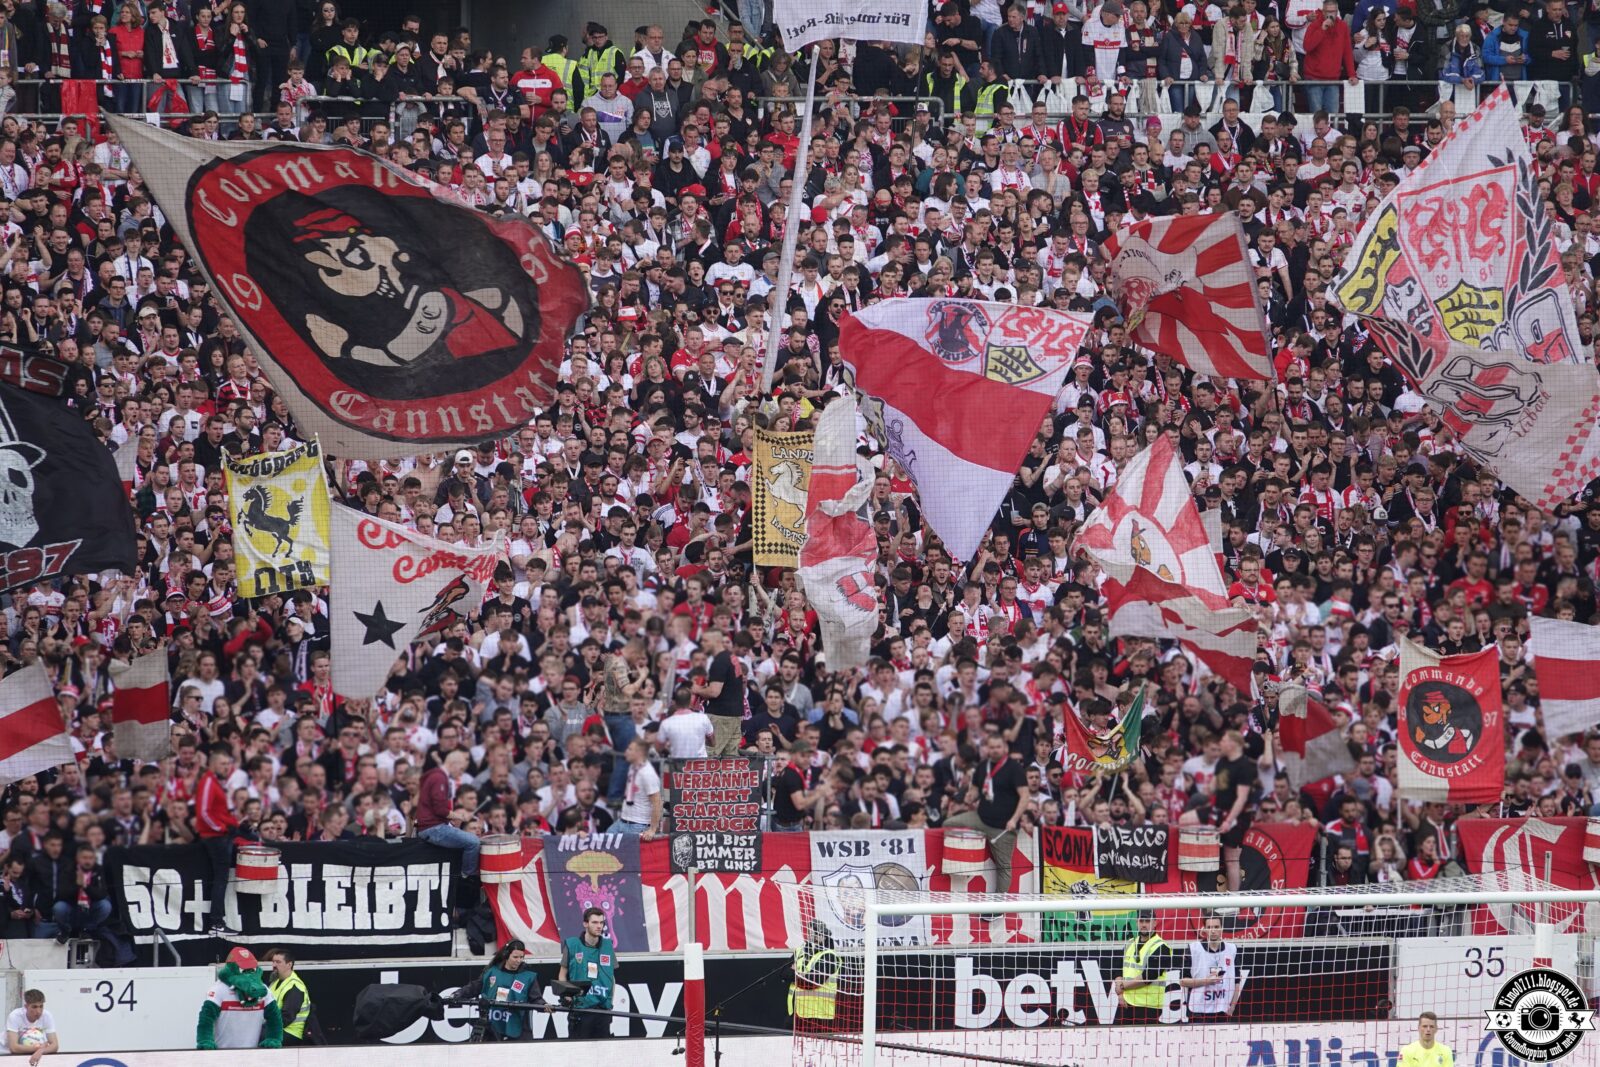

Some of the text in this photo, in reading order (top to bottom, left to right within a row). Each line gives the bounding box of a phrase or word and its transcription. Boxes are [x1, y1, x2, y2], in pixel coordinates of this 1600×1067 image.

[197, 155, 400, 228] Comman
[1404, 668, 1484, 697] Commando
[1483, 711, 1498, 728] 97
[682, 758, 750, 772] JEDER
[1410, 750, 1484, 778] Cannstatt
[672, 770, 760, 789] VERBANNTE
[682, 787, 753, 803] KEHRT
[695, 834, 757, 847] DU BIST
[816, 840, 871, 858] WSB
[1044, 828, 1094, 866] SCONV
[696, 847, 757, 860] IMMER
[696, 860, 757, 871] BEI UNS!
[259, 861, 451, 930] BLEIBT!
[1464, 946, 1505, 978] 35
[95, 979, 137, 1013] 34
